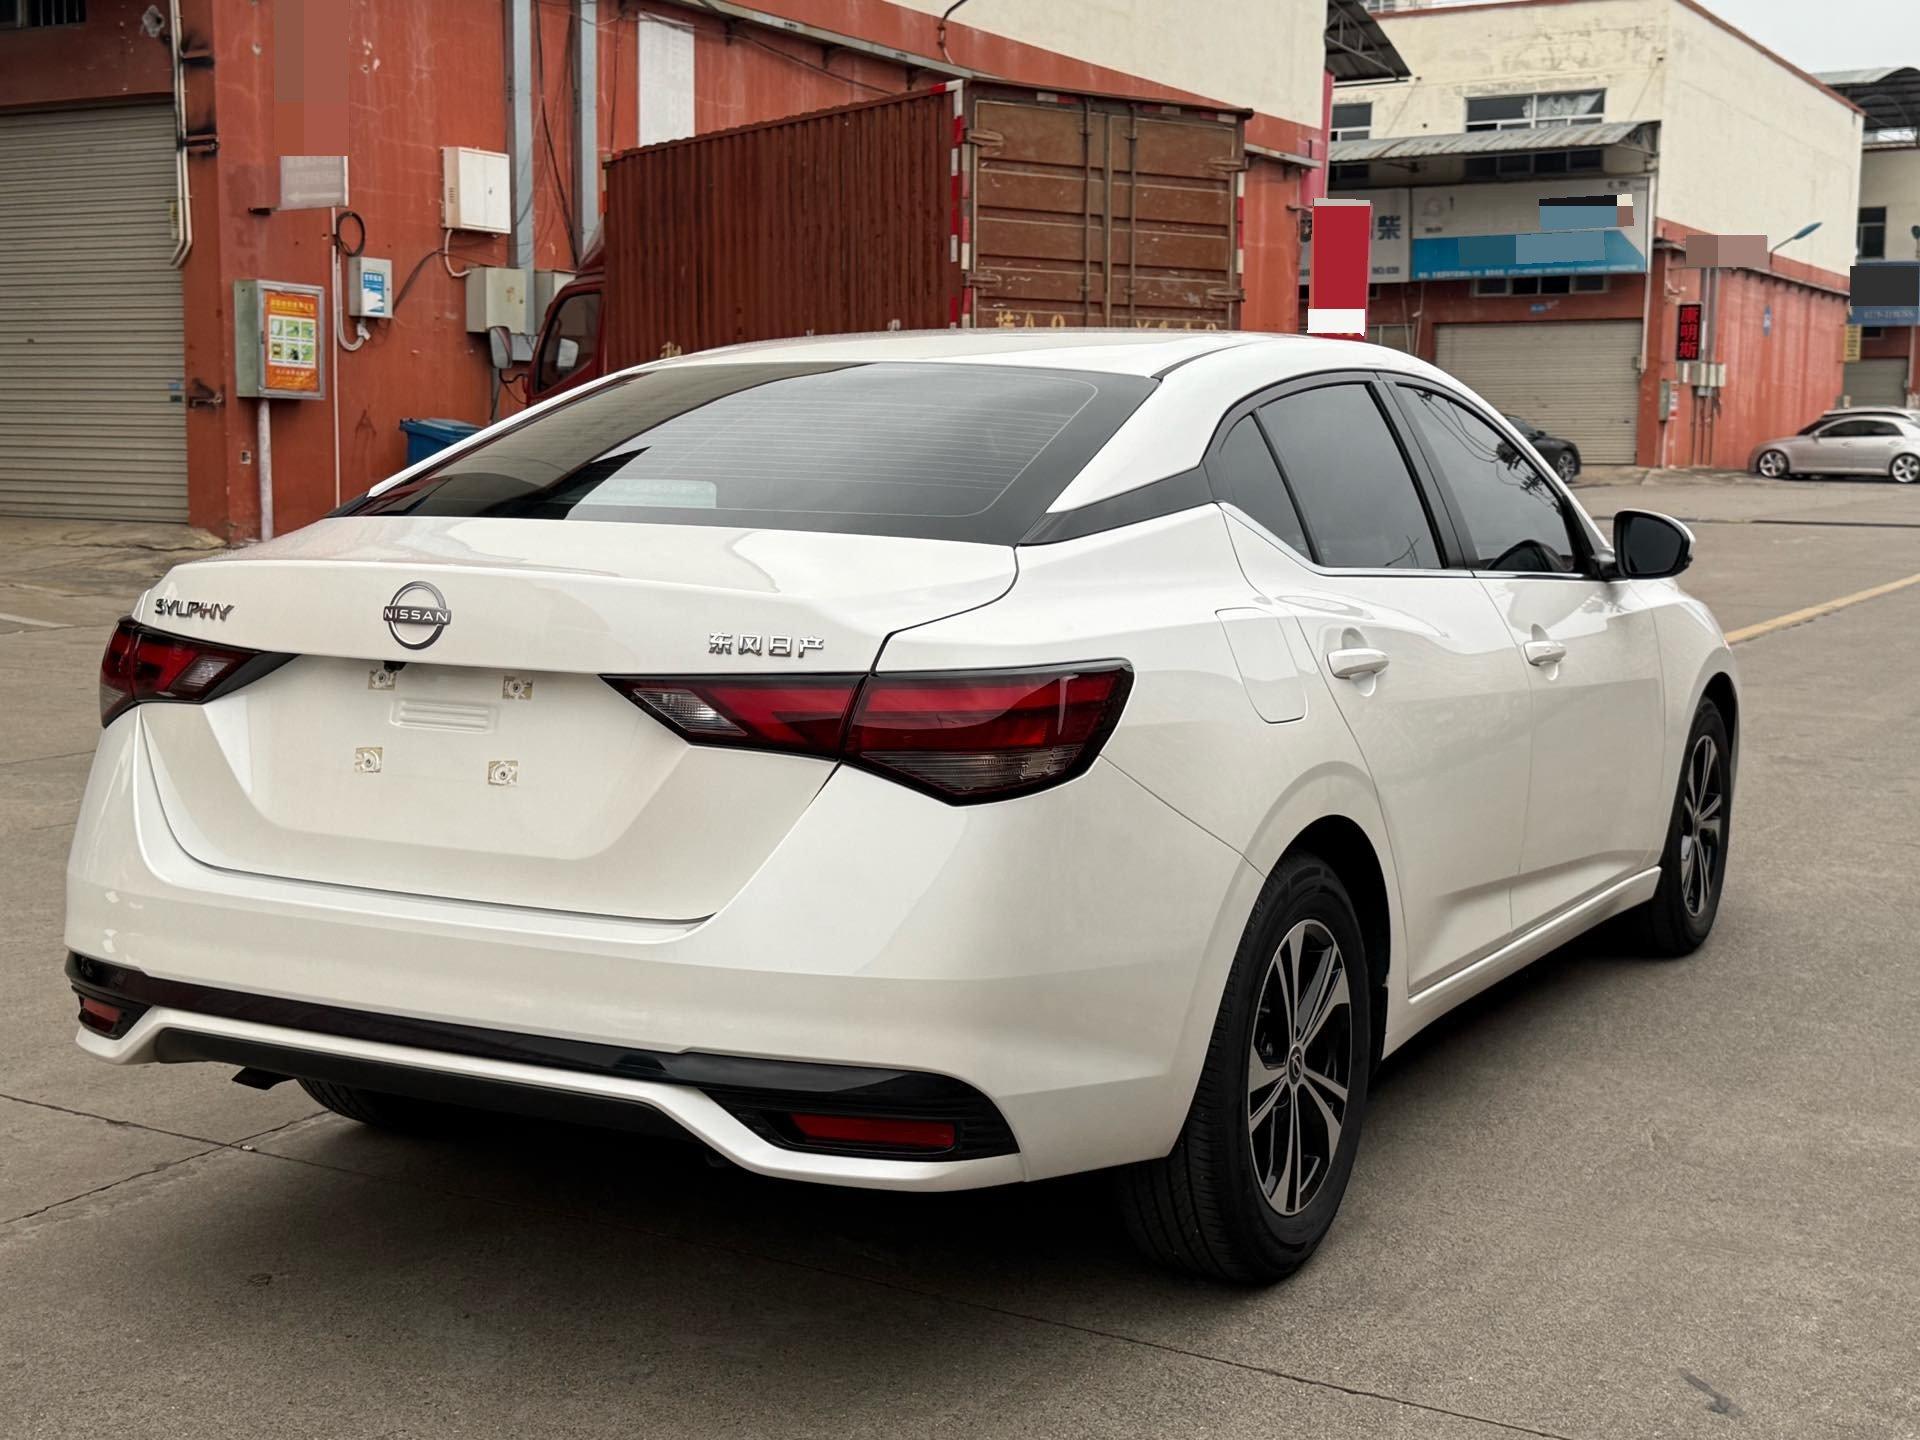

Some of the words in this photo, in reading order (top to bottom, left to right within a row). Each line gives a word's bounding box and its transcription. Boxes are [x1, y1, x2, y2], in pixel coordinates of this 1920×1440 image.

[155, 599, 234, 621] SYLPHY
[384, 608, 448, 622] NISSAN
[709, 632, 824, 658] 东风日产
